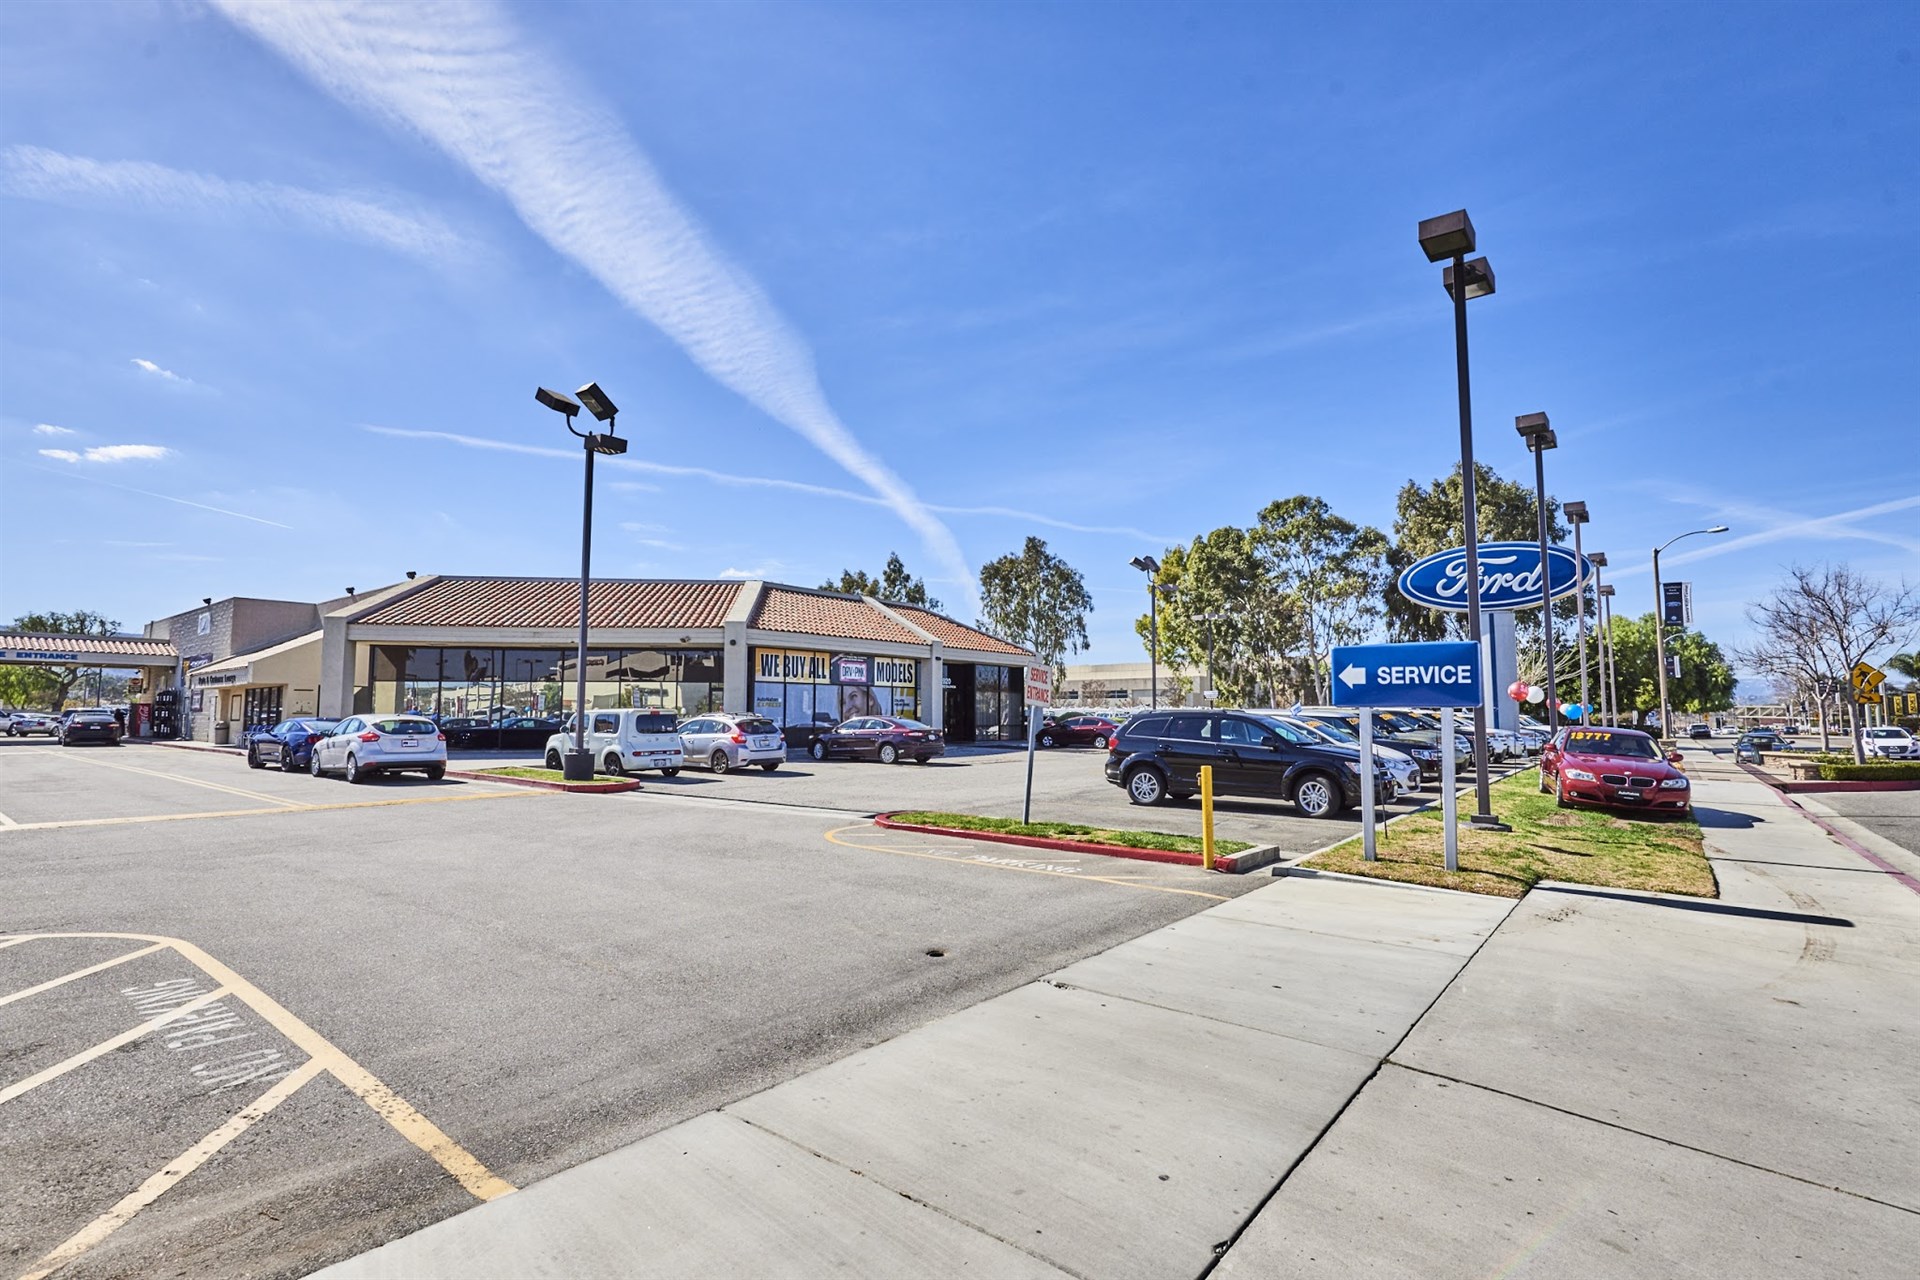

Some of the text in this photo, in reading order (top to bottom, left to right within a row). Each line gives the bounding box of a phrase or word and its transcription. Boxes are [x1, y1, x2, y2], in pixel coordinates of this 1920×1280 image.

[1436, 555, 1543, 597] Ford
[16, 651, 79, 660] ENTRANCE
[760, 653, 827, 679] WE BUY ALL
[876, 661, 914, 684] MODELS
[1030, 667, 1048, 684] SERVICE
[1377, 665, 1472, 685] SERVICE
[1027, 685, 1049, 703] ENTRANCE
